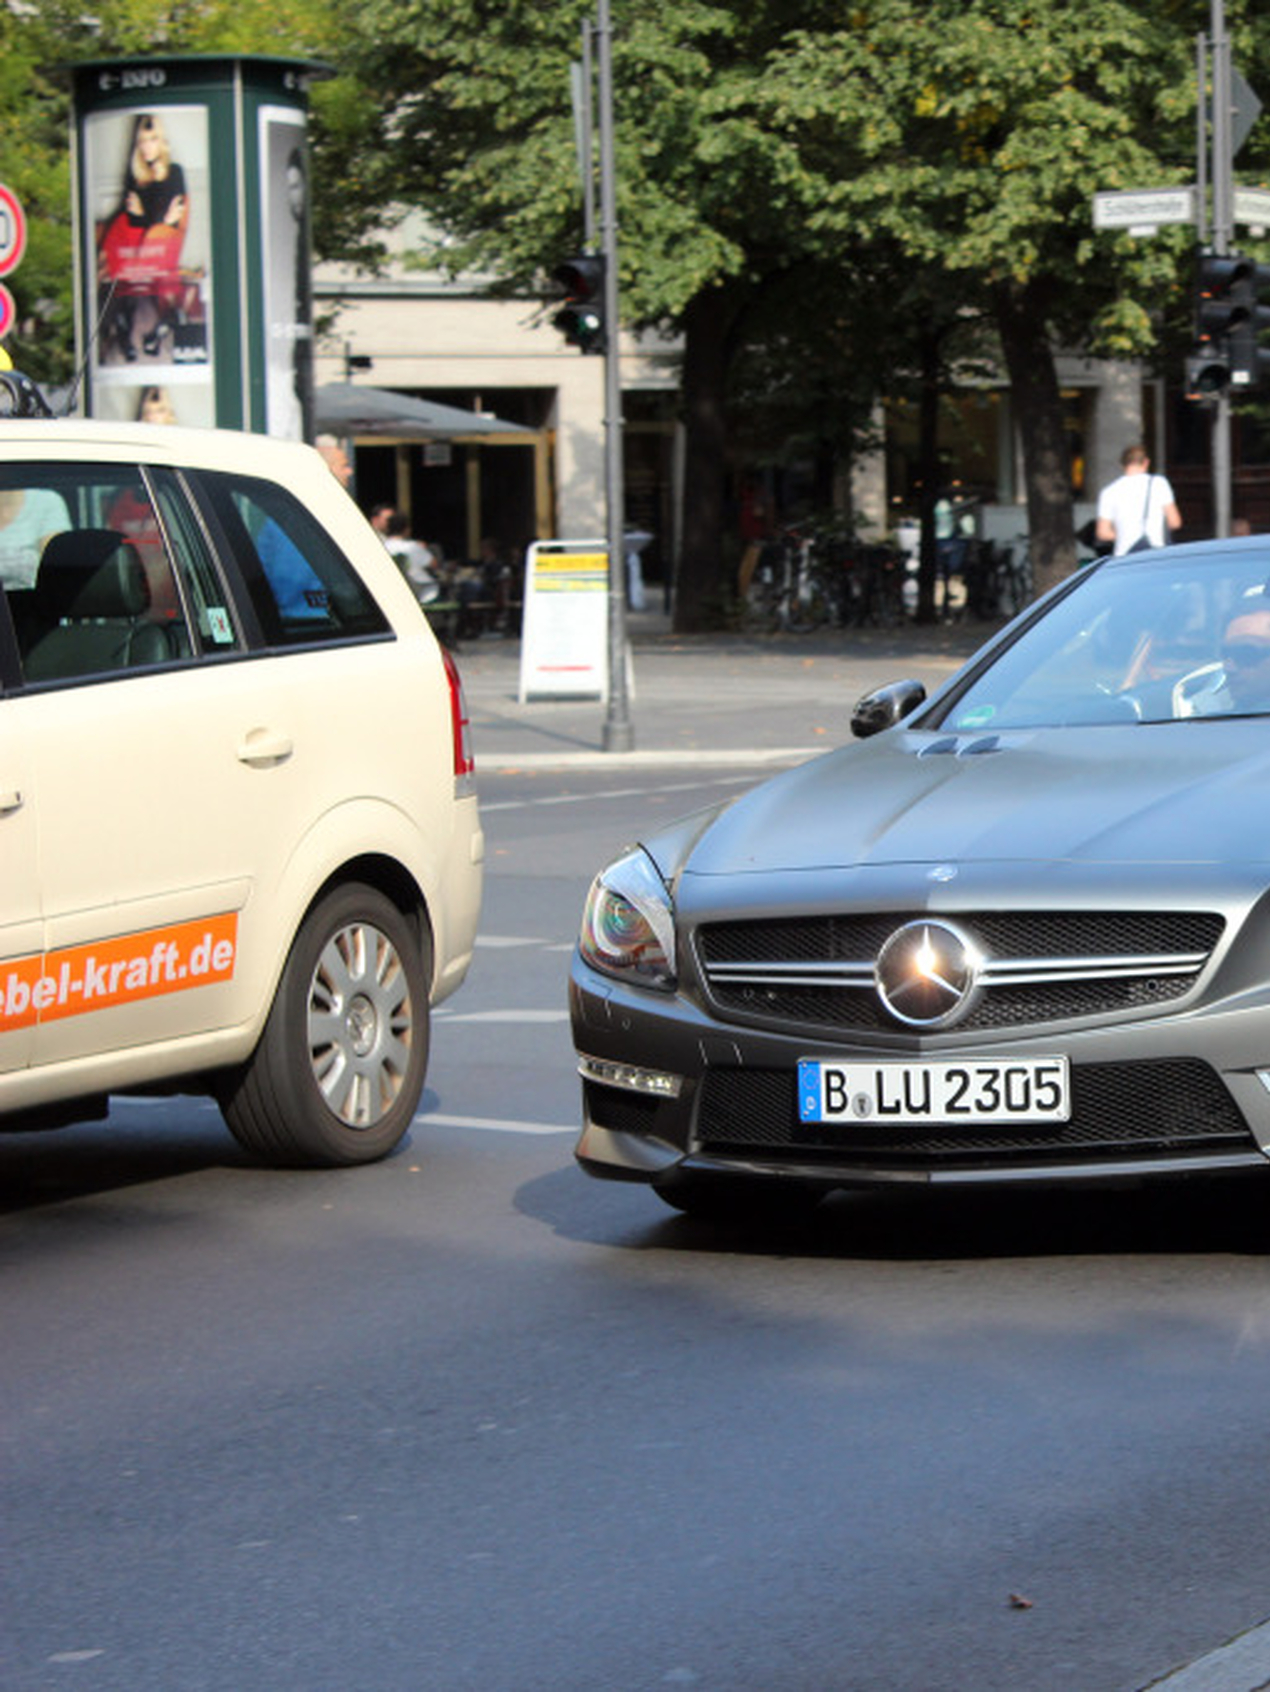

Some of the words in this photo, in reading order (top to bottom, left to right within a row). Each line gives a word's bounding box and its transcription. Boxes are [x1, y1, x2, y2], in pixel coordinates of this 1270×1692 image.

[0, 932, 234, 1016] bel-kraft.de
[824, 1069, 848, 1114] B
[875, 1069, 931, 1114] LU
[945, 1066, 1062, 1113] 2305
